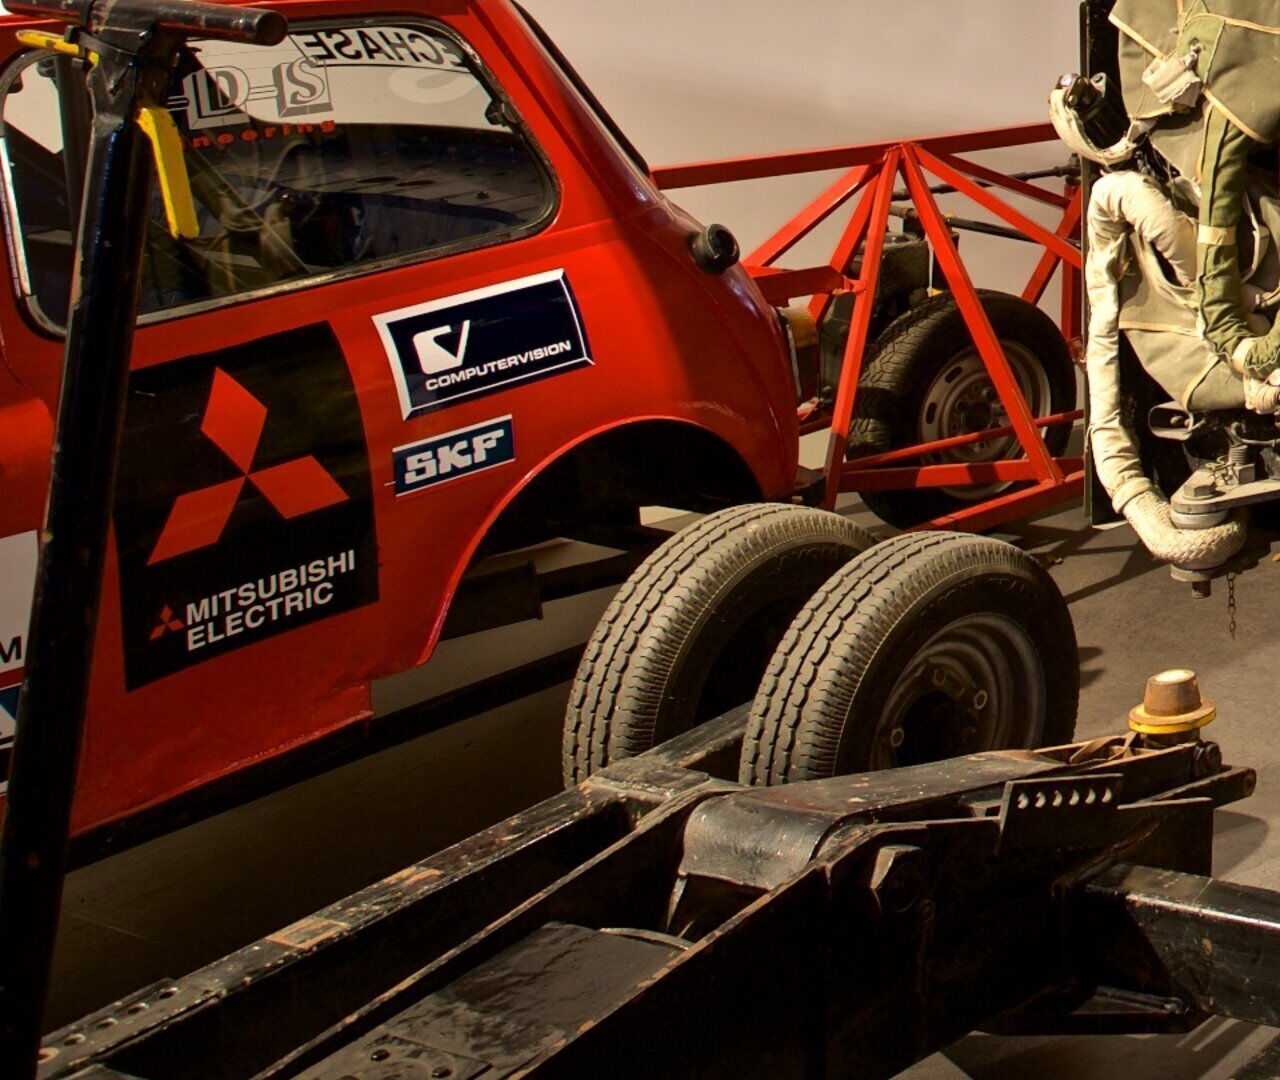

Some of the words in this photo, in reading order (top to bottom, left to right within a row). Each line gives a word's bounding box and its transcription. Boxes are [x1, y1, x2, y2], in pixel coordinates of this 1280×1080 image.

[425, 340, 572, 391] COMPUTERVISION
[405, 429, 505, 485] SKF
[186, 549, 356, 626] MITSUBISHI
[187, 582, 334, 651] ELECTRIC
